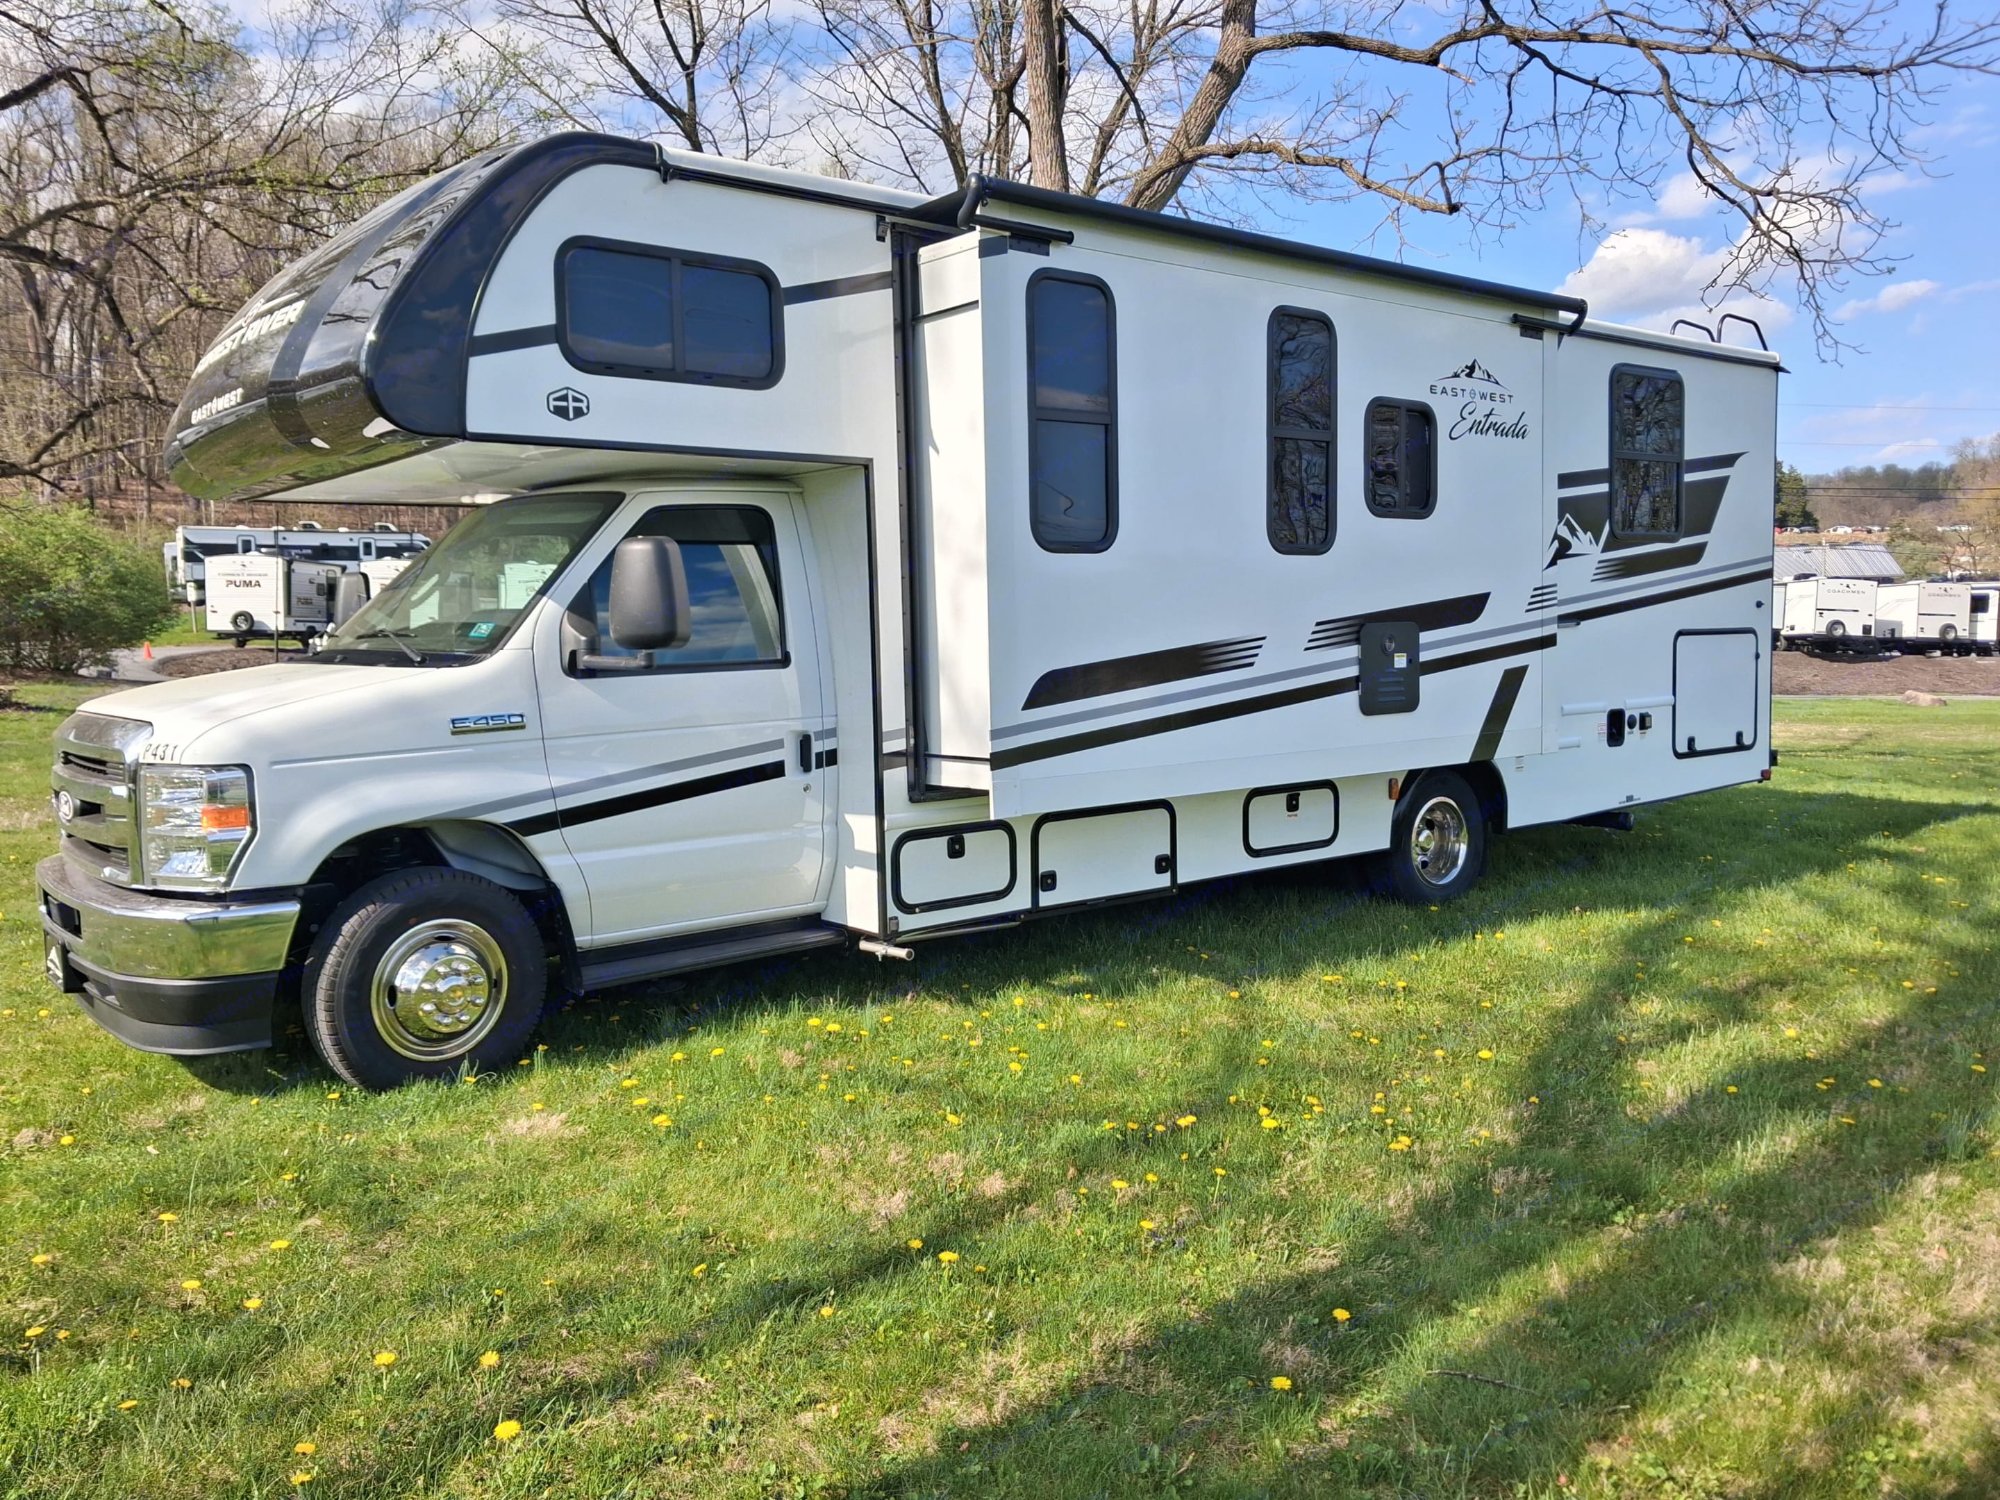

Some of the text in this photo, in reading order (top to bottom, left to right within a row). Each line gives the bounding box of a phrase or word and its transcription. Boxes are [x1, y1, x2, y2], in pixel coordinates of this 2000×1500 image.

[241, 299, 306, 345] RIVER
[1429, 384, 1514, 404] EAST WEST
[1448, 400, 1530, 441] Entrada
[225, 579, 262, 588] PUMA
